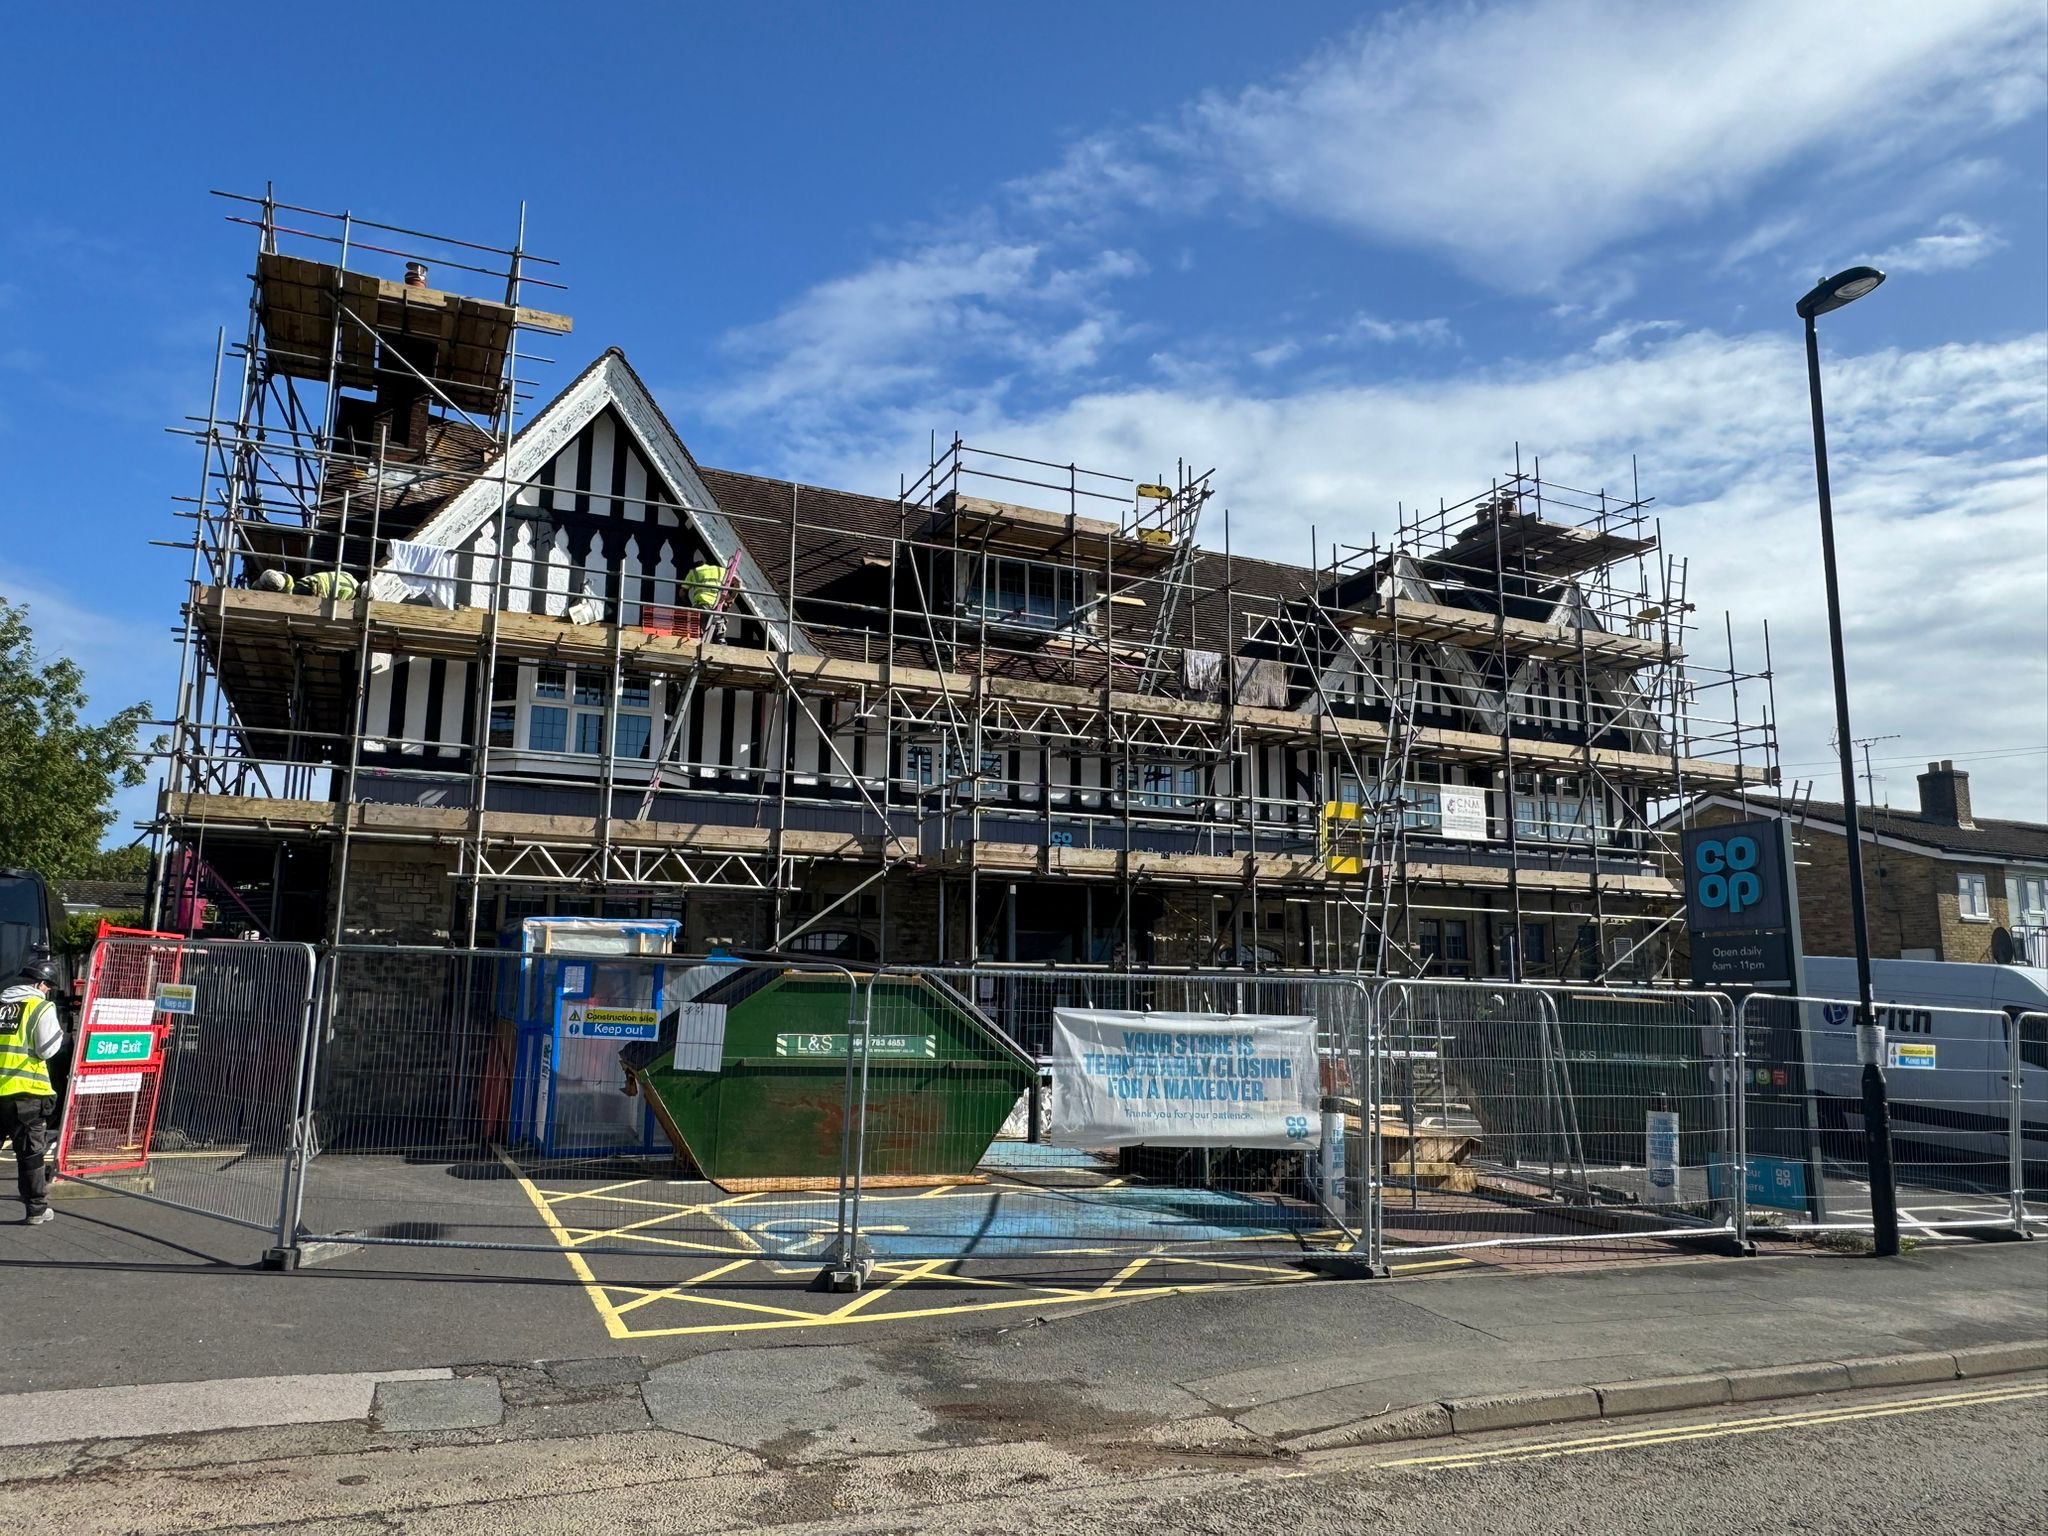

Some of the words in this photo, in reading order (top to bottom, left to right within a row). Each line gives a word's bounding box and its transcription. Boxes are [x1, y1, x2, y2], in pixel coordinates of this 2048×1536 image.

[1712, 946, 1738, 957] Open
[1740, 945, 1763, 956] daily
[1712, 961, 1732, 971] 6am
[1740, 961, 1765, 971] 11pm
[586, 1012, 637, 1022] Construction
[639, 1014, 654, 1022] site
[594, 1023, 622, 1035] Keep
[625, 1025, 644, 1035] out
[97, 1040, 119, 1054] Site
[121, 1040, 142, 1053] Exit
[798, 1035, 832, 1050] L&S
[1123, 1032, 1172, 1054] YOUR
[1175, 1033, 1233, 1055] STORE
[1237, 1035, 1253, 1056] IS
[1216, 1057, 1292, 1079] CLOSING
[1107, 1076, 1143, 1099] FOR
[1146, 1078, 1159, 1099] A
[1163, 1079, 1268, 1101] MAKEOVER.
[1124, 1108, 1152, 1118] Thank
[1153, 1110, 1172, 1119] you
[1174, 1109, 1188, 1118] for
[1188, 1111, 1209, 1120] your
